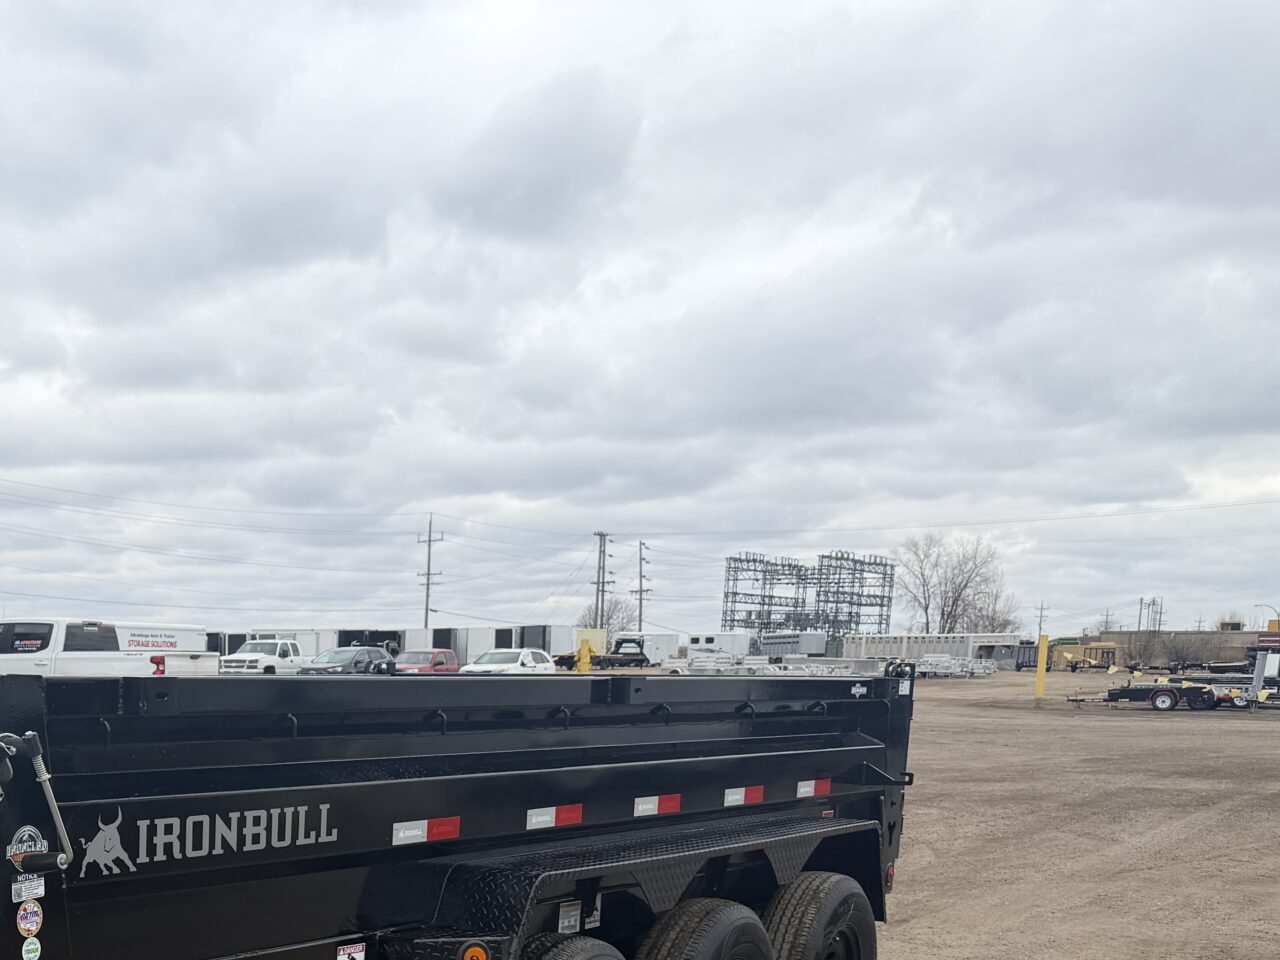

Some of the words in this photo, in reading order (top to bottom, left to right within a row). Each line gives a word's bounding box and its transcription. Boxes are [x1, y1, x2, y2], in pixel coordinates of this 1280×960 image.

[128, 639, 150, 648] STORAGE
[150, 640, 177, 649] SOLUTIONS
[136, 803, 338, 864] IRONBULL
[6, 840, 48, 858] IRONCLAD
[17, 873, 38, 882] NOTICE
